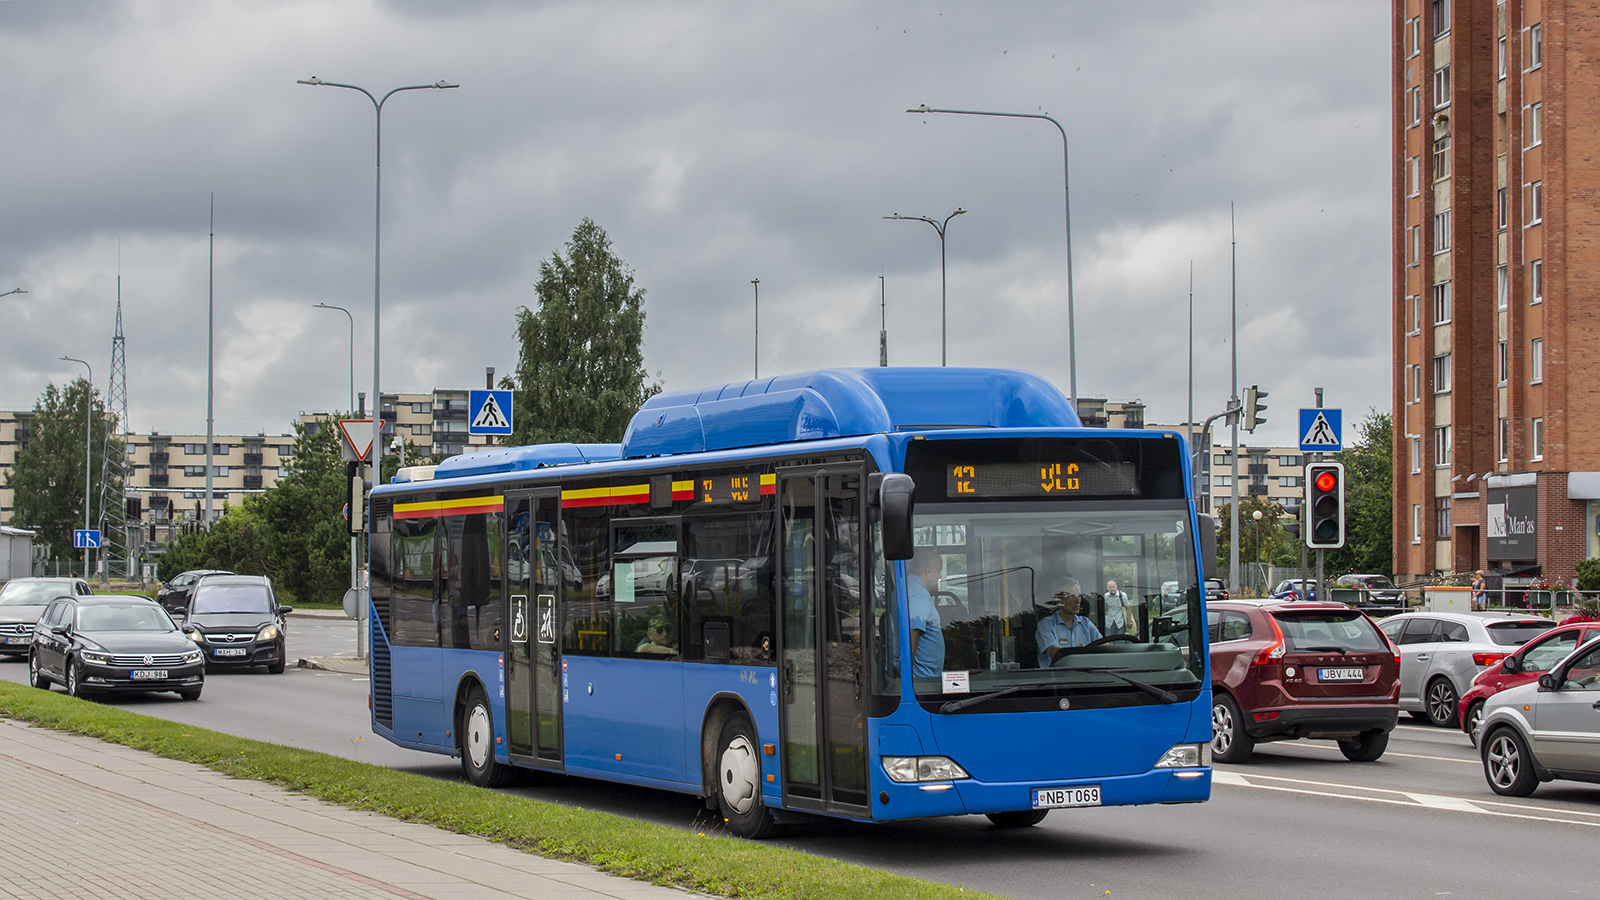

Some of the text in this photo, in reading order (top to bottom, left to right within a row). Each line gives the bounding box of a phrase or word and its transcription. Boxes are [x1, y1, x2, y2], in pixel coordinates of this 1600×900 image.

[953, 463, 1079, 493] 12 VLG
[1324, 670, 1362, 678] JBV 444
